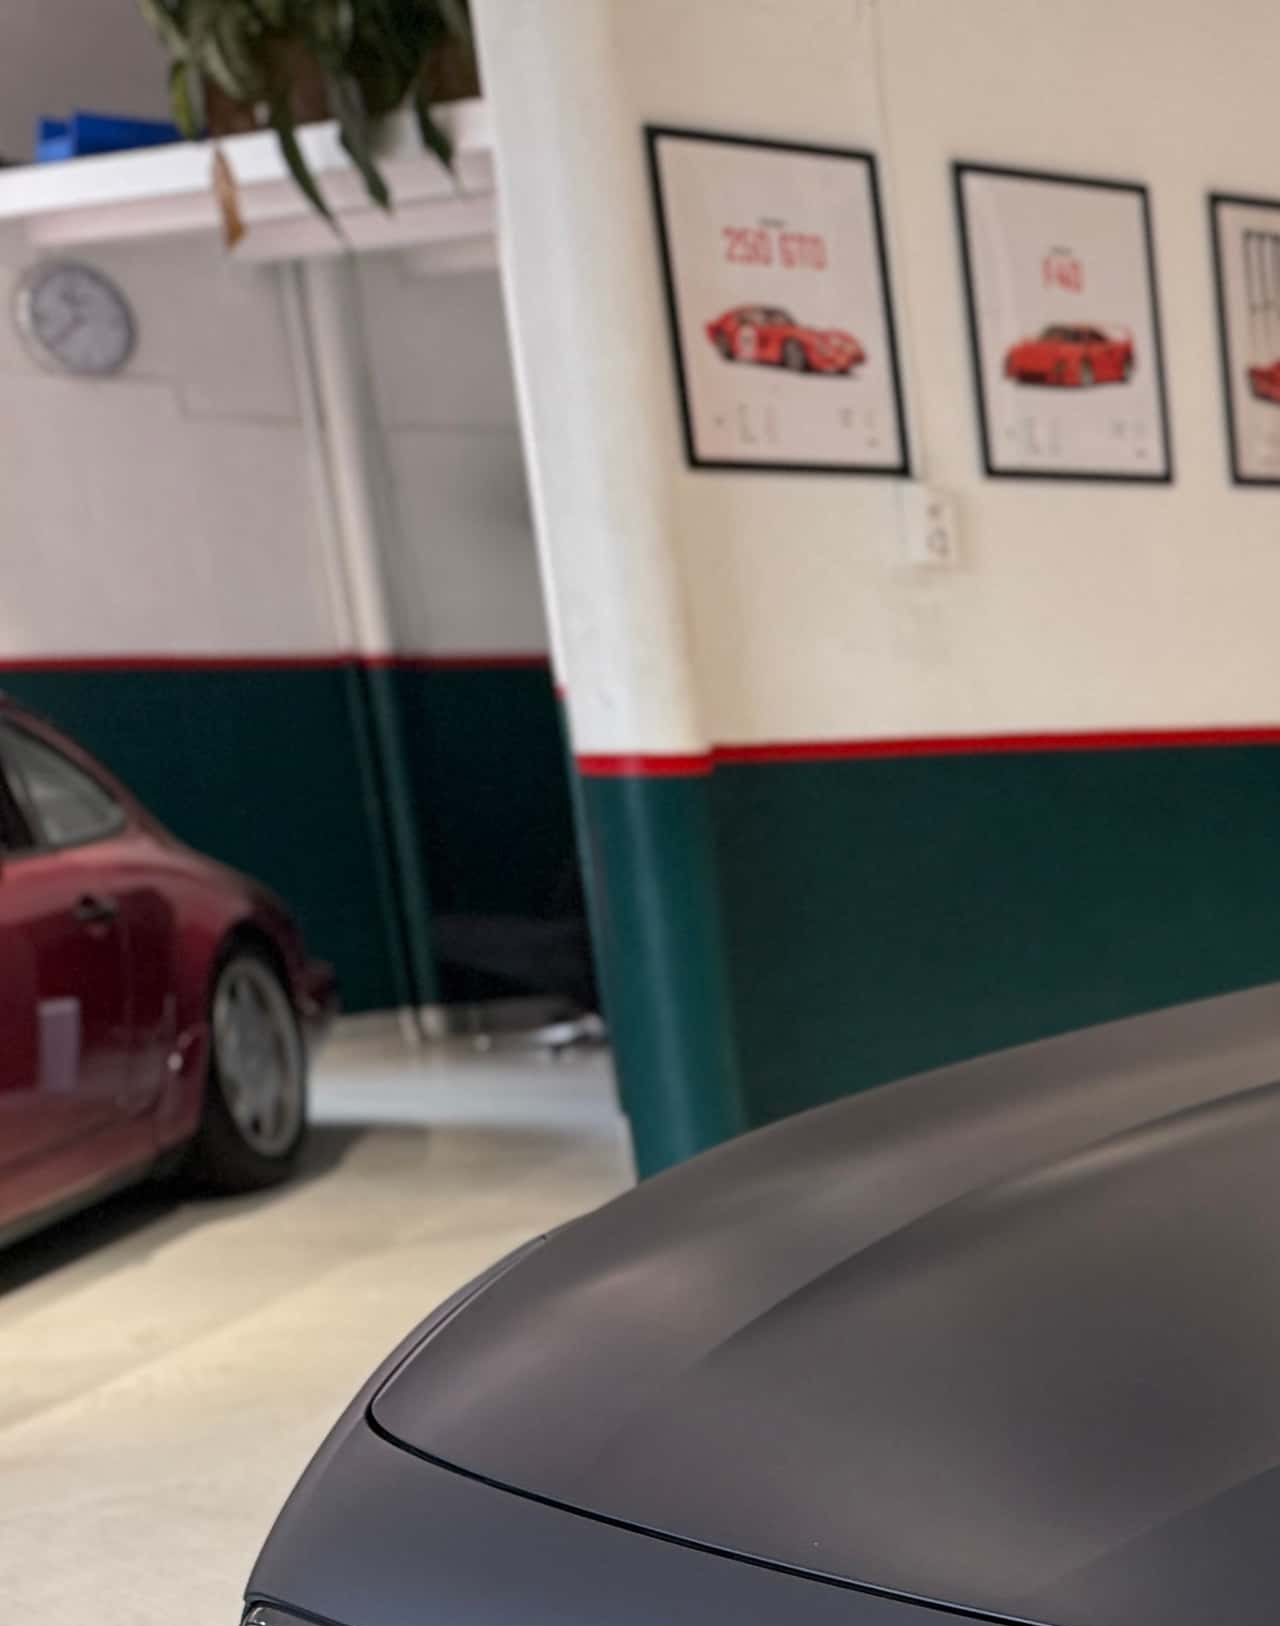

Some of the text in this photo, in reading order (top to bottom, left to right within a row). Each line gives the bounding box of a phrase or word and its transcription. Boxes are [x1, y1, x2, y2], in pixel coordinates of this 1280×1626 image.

[720, 226, 828, 271] 250 GTO
[1041, 256, 1085, 295] F40
